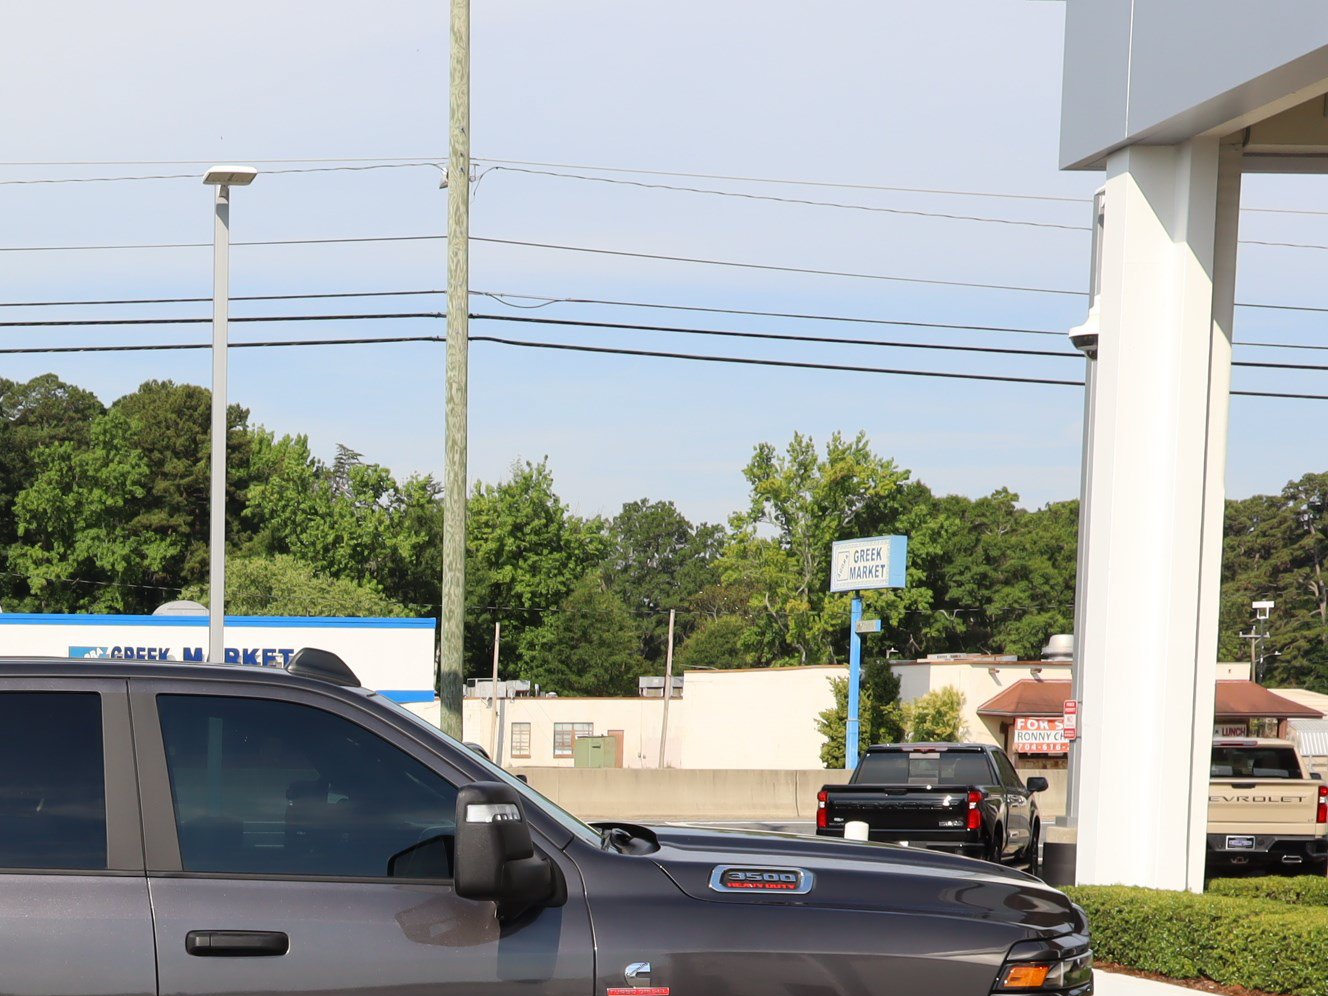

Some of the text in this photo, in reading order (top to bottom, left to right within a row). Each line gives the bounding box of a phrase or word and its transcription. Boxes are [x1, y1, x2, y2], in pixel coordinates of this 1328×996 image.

[854, 547, 882, 563] GREEK
[850, 565, 886, 580] MARKET
[111, 646, 170, 660] GREEK
[183, 648, 294, 668] MRKET
[1017, 719, 1050, 730] FOR
[1017, 731, 1051, 741] RONNY
[1221, 728, 1245, 737] LUNCH
[728, 871, 797, 882] 3500
